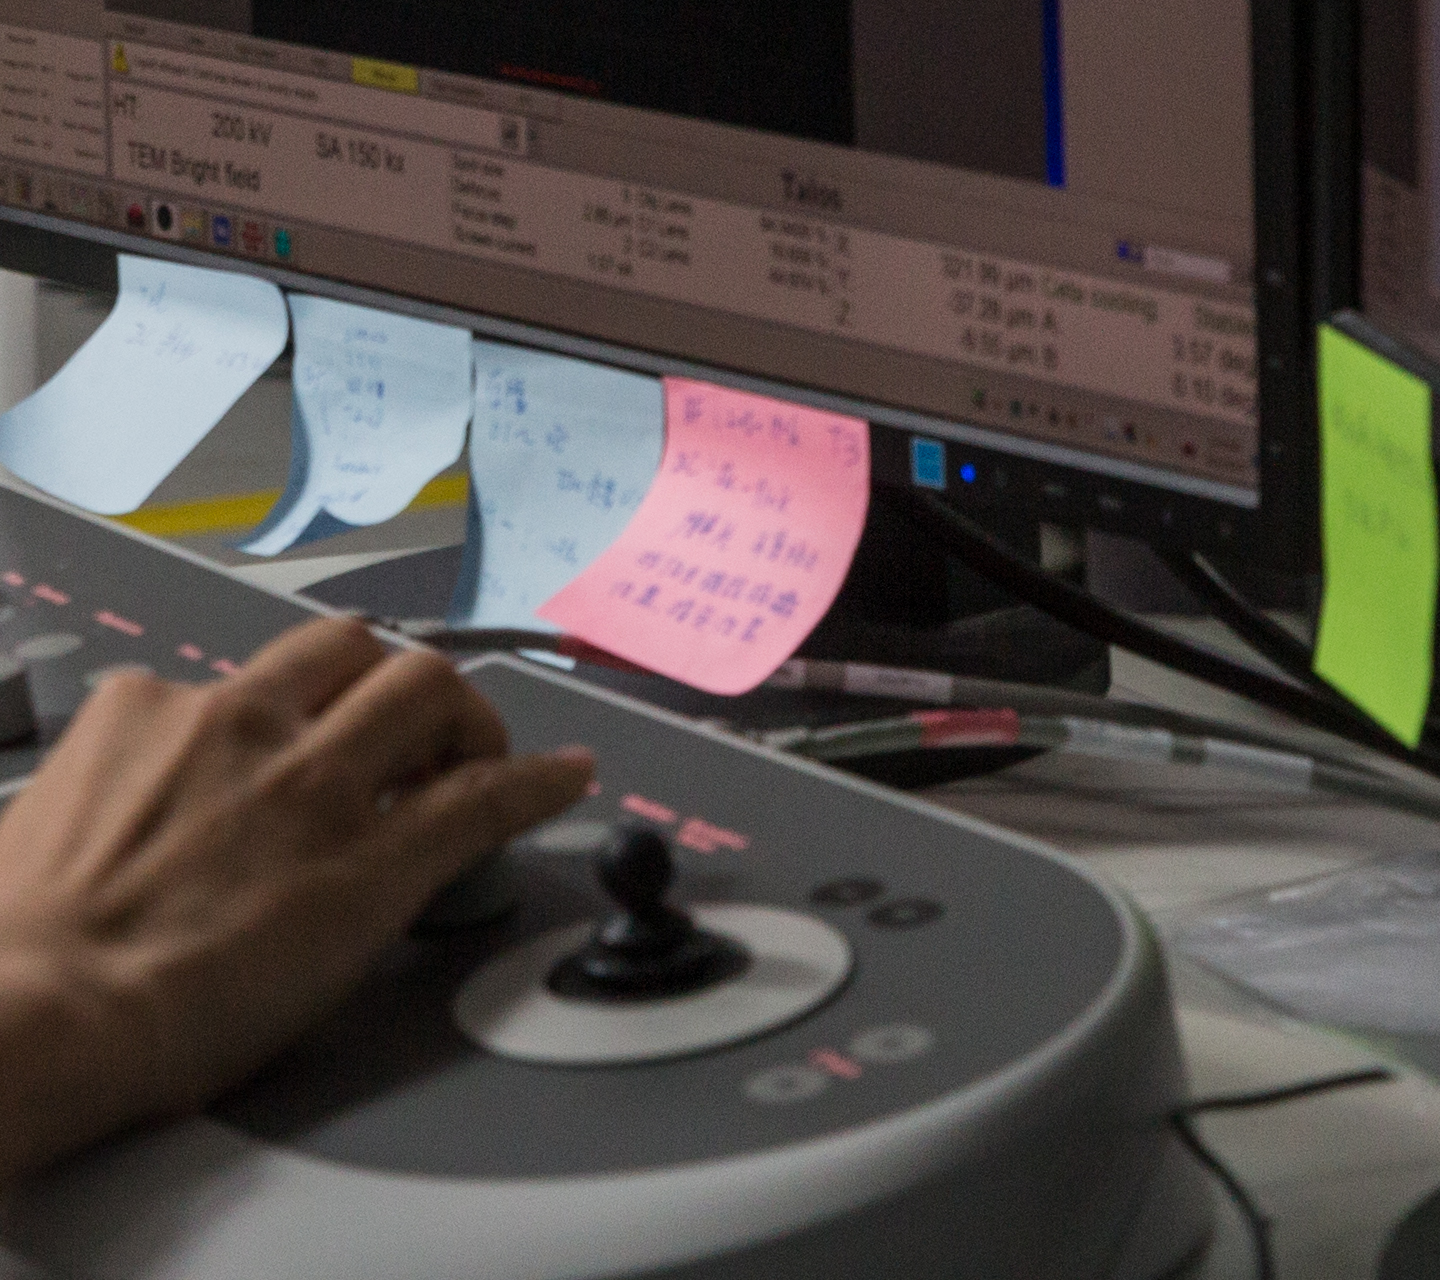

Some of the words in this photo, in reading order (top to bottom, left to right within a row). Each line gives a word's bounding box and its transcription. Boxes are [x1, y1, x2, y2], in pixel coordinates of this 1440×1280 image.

[213, 112, 246, 141] 200
[128, 139, 166, 171] TEM
[172, 148, 220, 187] Bright
[224, 159, 262, 191] field
